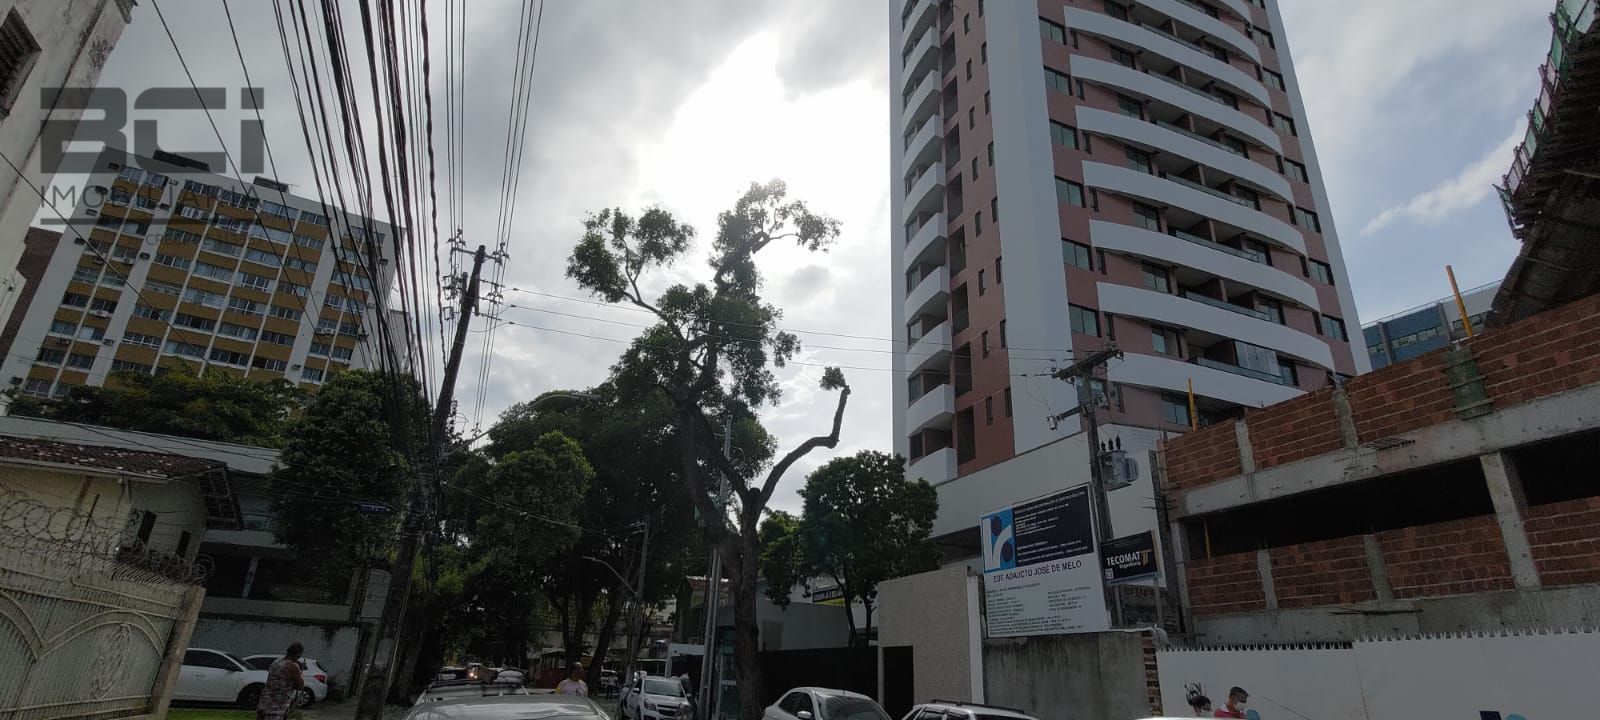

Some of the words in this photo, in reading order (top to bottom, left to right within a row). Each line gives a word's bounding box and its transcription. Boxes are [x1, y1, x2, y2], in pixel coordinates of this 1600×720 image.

[1106, 551, 1141, 566] TECOMAT
[993, 574, 1006, 583] EDF.
[1006, 569, 1033, 582] ADAUCTO
[1033, 563, 1051, 576] JOSÉ
[1051, 563, 1061, 573] DE
[1061, 559, 1082, 571] MELO
